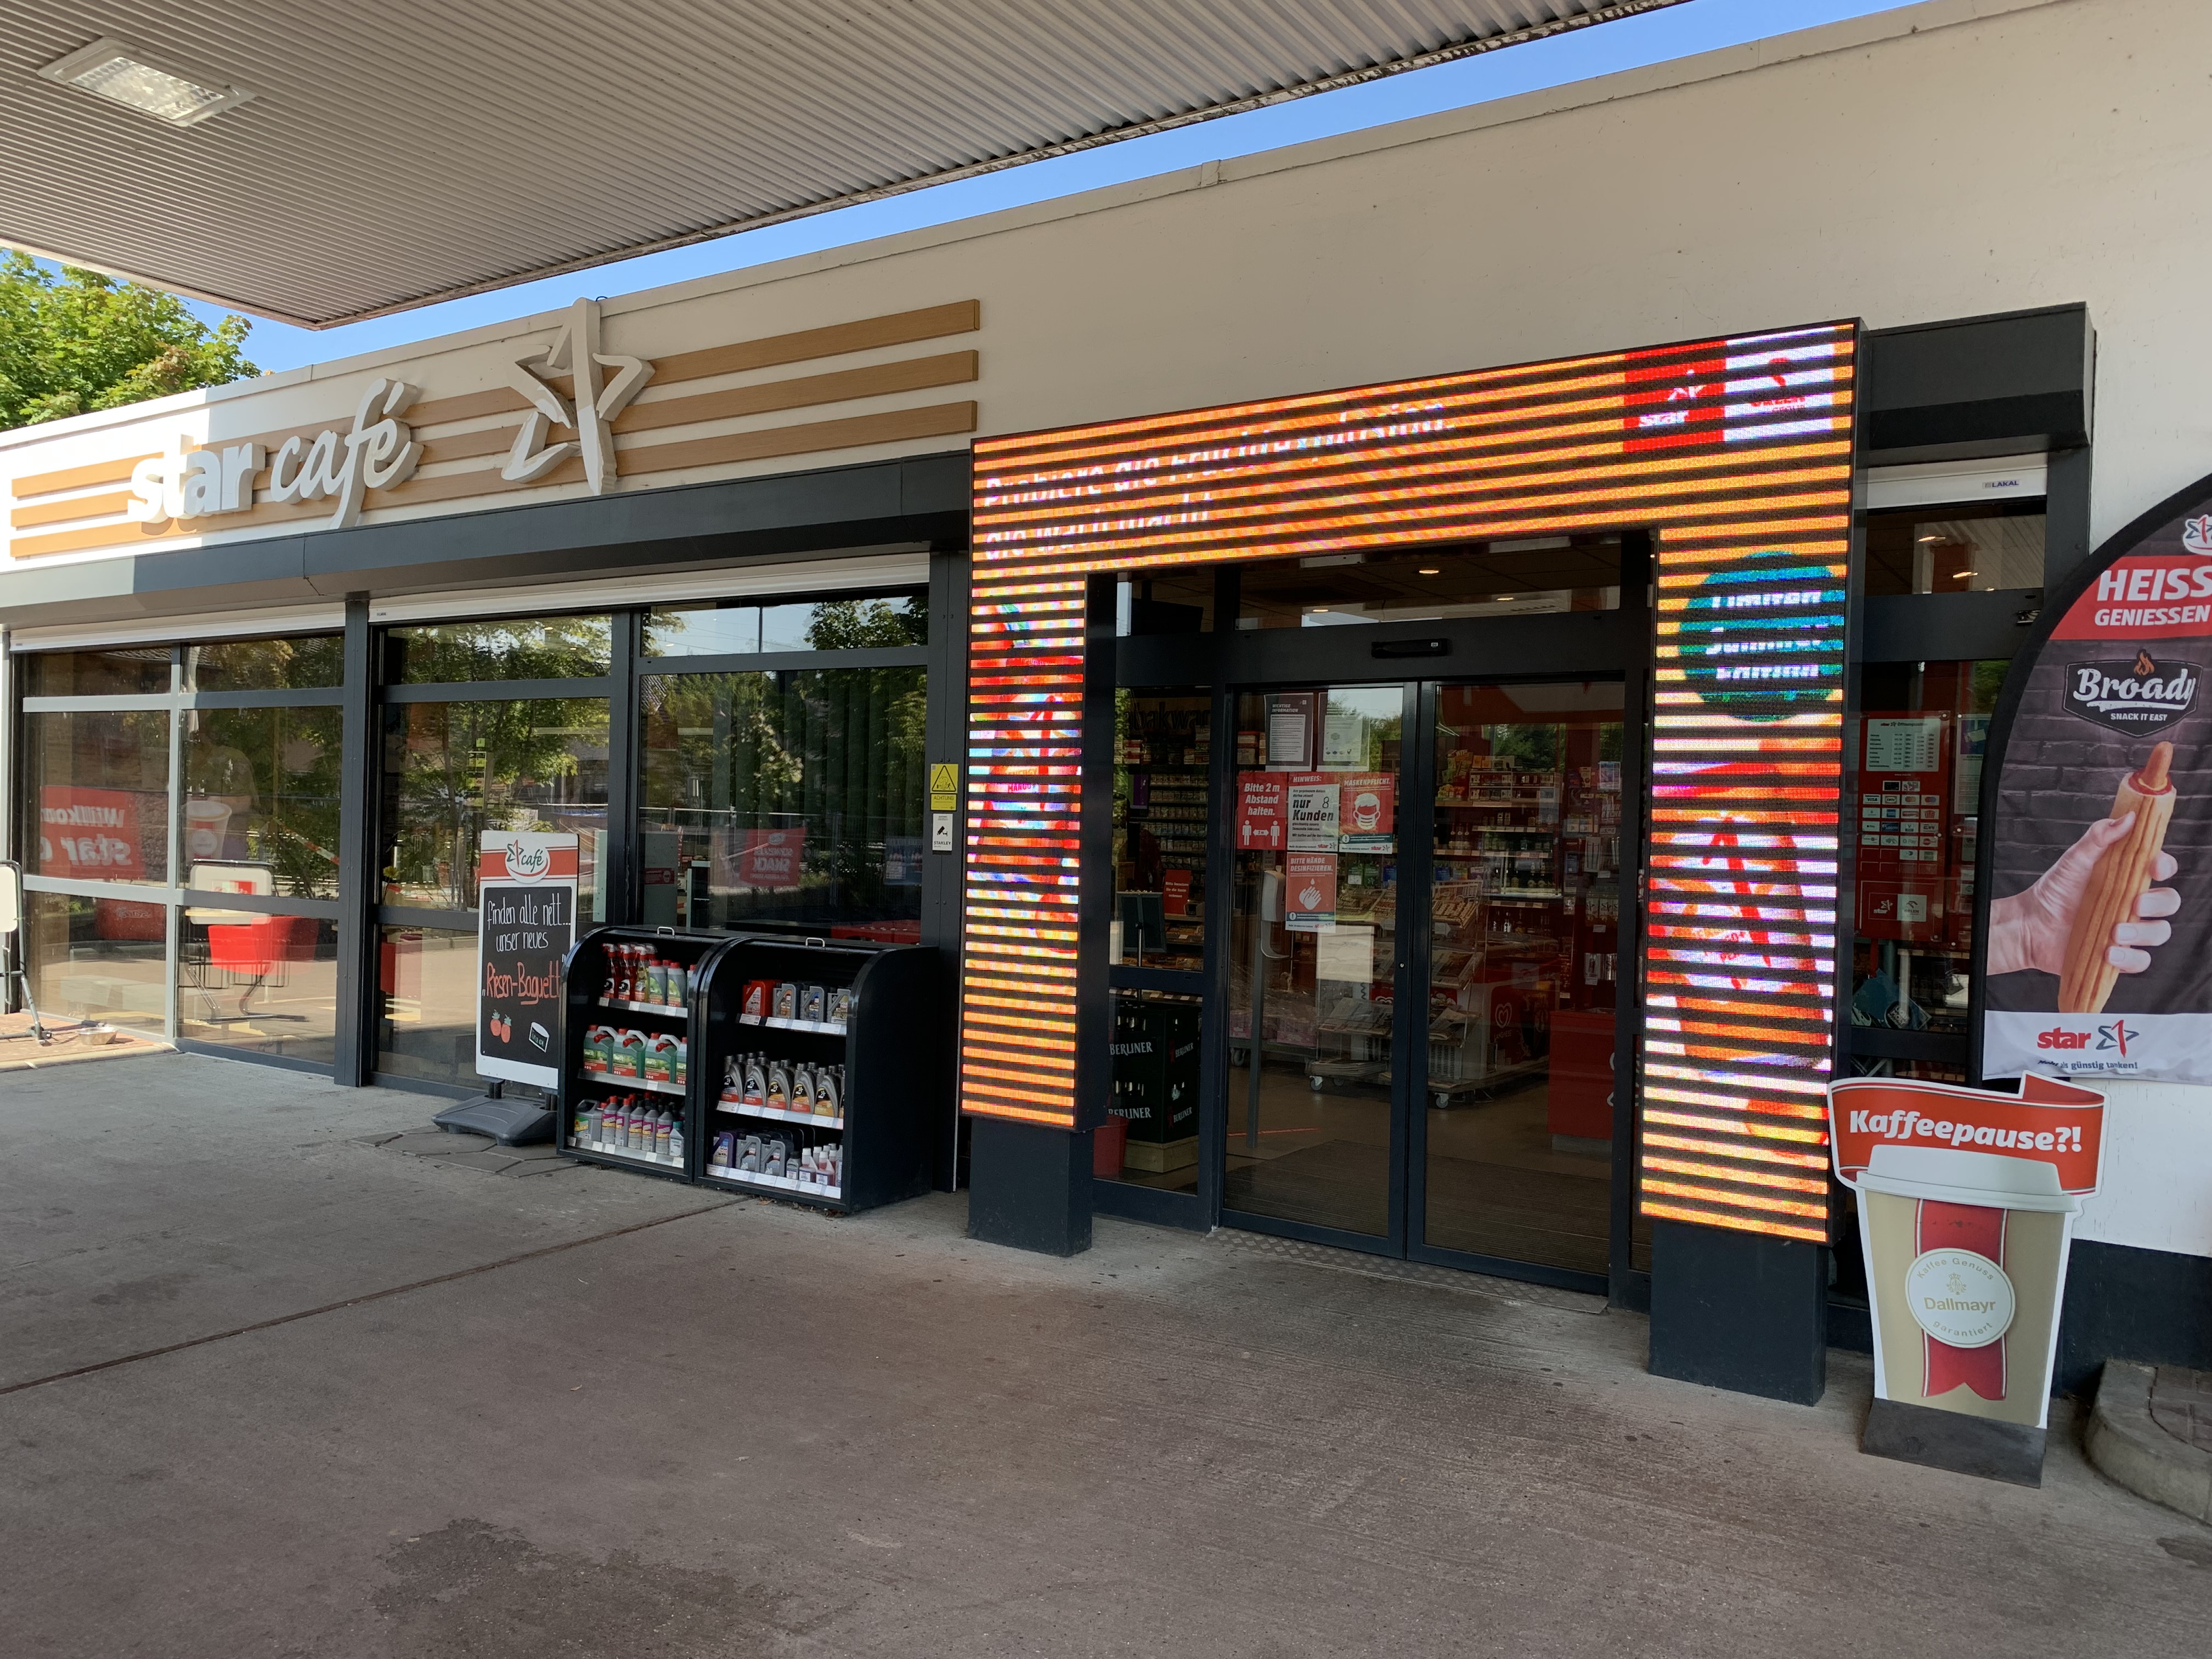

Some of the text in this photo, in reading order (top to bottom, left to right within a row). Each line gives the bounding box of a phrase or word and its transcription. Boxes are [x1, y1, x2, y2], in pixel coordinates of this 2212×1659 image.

[127, 377, 425, 529] star café
[2097, 567, 2212, 602] HEISS
[2095, 605, 2211, 627] GENIESSEN
[2073, 668, 2196, 710] Broady
[2111, 713, 2139, 721] SNACK
[2149, 713, 2168, 721] EASY
[1244, 783, 1265, 792] Bitte
[1265, 783, 1272, 792] 2
[1344, 778, 1391, 786] MASKENPFLICHT.
[1245, 795, 1279, 804] Abstand
[1293, 799, 1311, 808] nur
[1322, 797, 1329, 809] 8
[1248, 806, 1276, 816] halten.
[1293, 810, 1334, 821] Kunden
[521, 849, 544, 873] café
[488, 896, 516, 930] finden
[519, 894, 538, 925] alle
[496, 931, 548, 953] unser neues
[1494, 1029, 1512, 1040] LANGNESE
[2037, 1027, 2091, 1049] star
[1109, 1042, 1194, 1058] BERLINER BERLINER
[2071, 1060, 2104, 1071] günstig
[2106, 1062, 2138, 1070] tanken!
[1173, 1107, 1192, 1123] BERLINER
[1850, 1109, 2083, 1153] Kaffeepause?!
[1916, 1257, 1995, 1282] Kaffee Genuss
[1924, 1296, 1996, 1314] Dallmayr
[1932, 1321, 1994, 1338] garantiert
